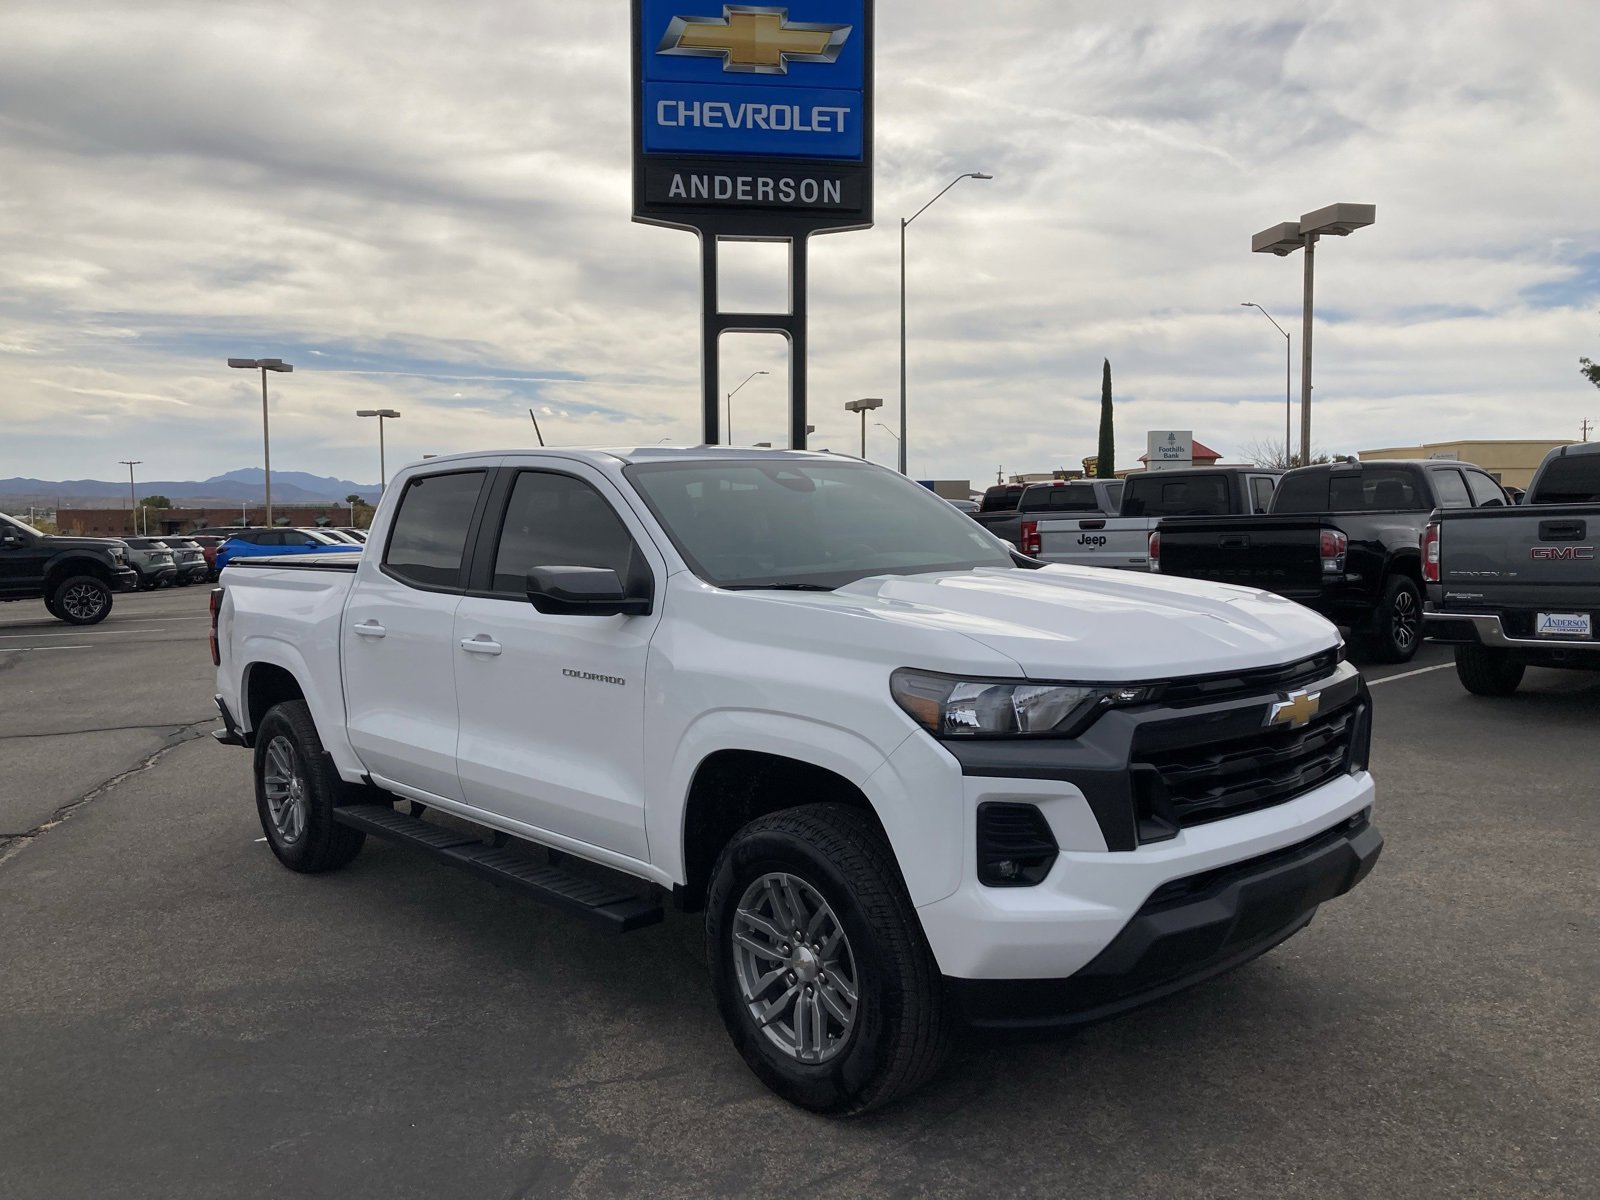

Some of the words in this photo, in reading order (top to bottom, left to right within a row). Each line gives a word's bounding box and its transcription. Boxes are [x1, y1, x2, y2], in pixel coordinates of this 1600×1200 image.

[656, 100, 851, 133] CHEVROLET
[668, 173, 842, 204] ANDERSON
[1077, 533, 1107, 547] Jeep
[1530, 546, 1594, 560] GMC
[1541, 617, 1588, 631] ANDERSON
[562, 668, 626, 686] COLORADO
